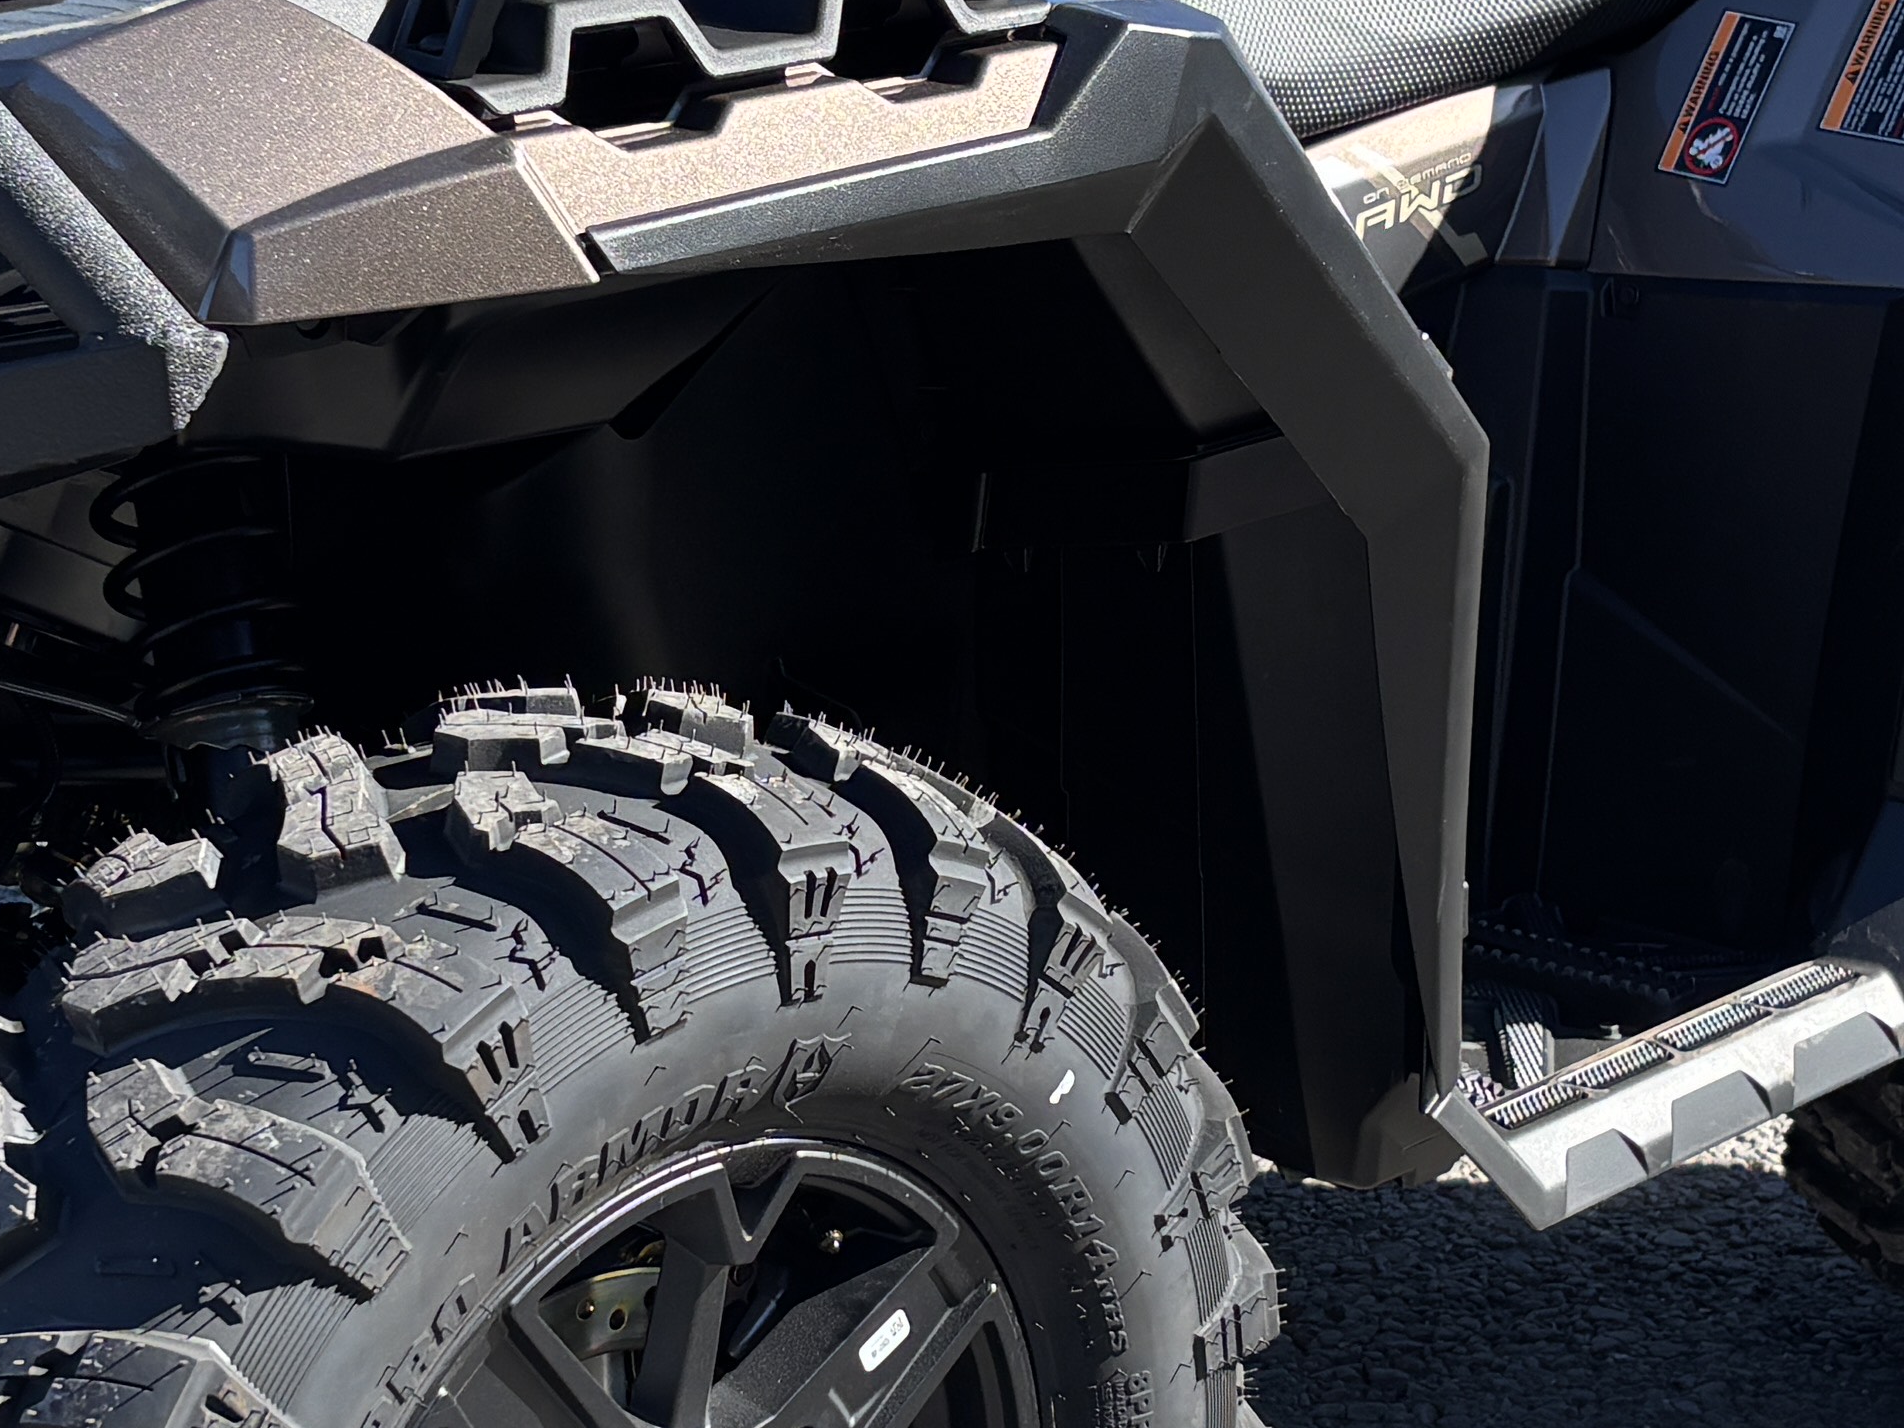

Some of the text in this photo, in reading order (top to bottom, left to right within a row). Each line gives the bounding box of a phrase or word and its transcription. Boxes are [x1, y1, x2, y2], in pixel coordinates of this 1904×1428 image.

[1851, 0, 1890, 71] WARNING
[1682, 50, 1720, 118] WARNING
[1356, 163, 1482, 241] AWD
